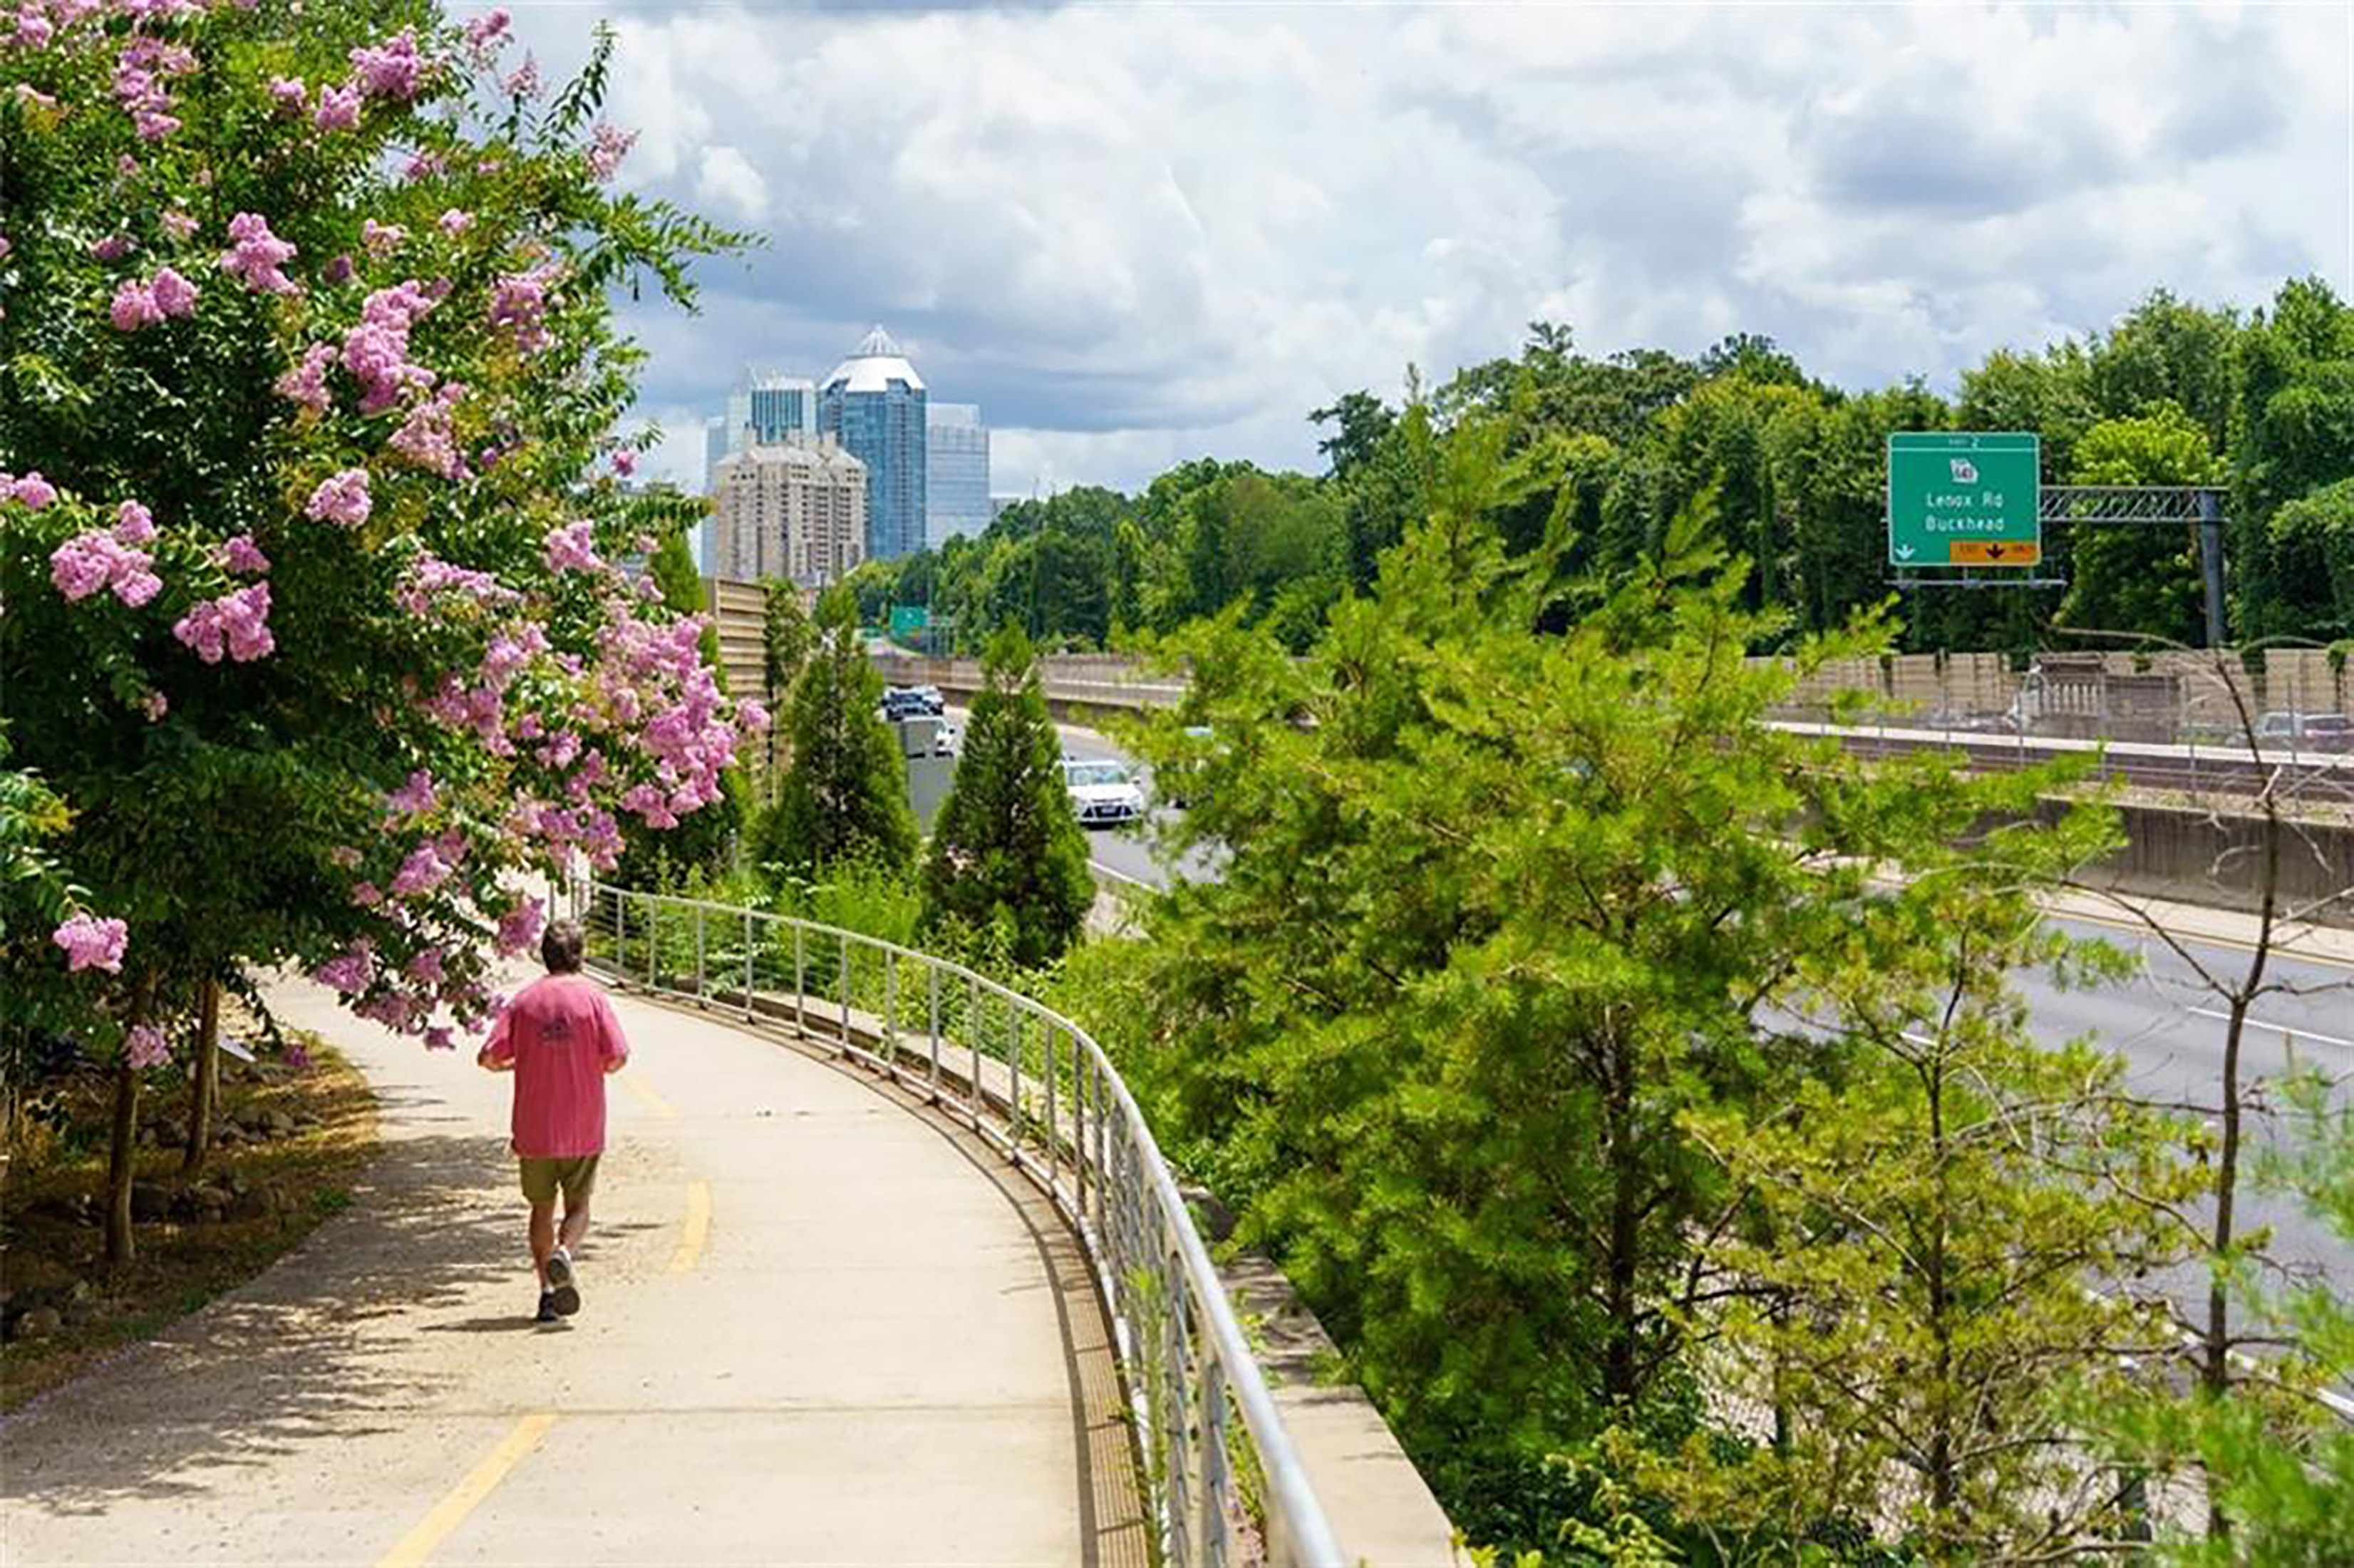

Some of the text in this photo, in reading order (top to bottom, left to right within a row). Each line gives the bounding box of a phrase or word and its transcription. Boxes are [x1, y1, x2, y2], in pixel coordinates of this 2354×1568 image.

[1926, 490, 2003, 507] Lenox Rd
[1925, 514, 2004, 532] Buckhead
